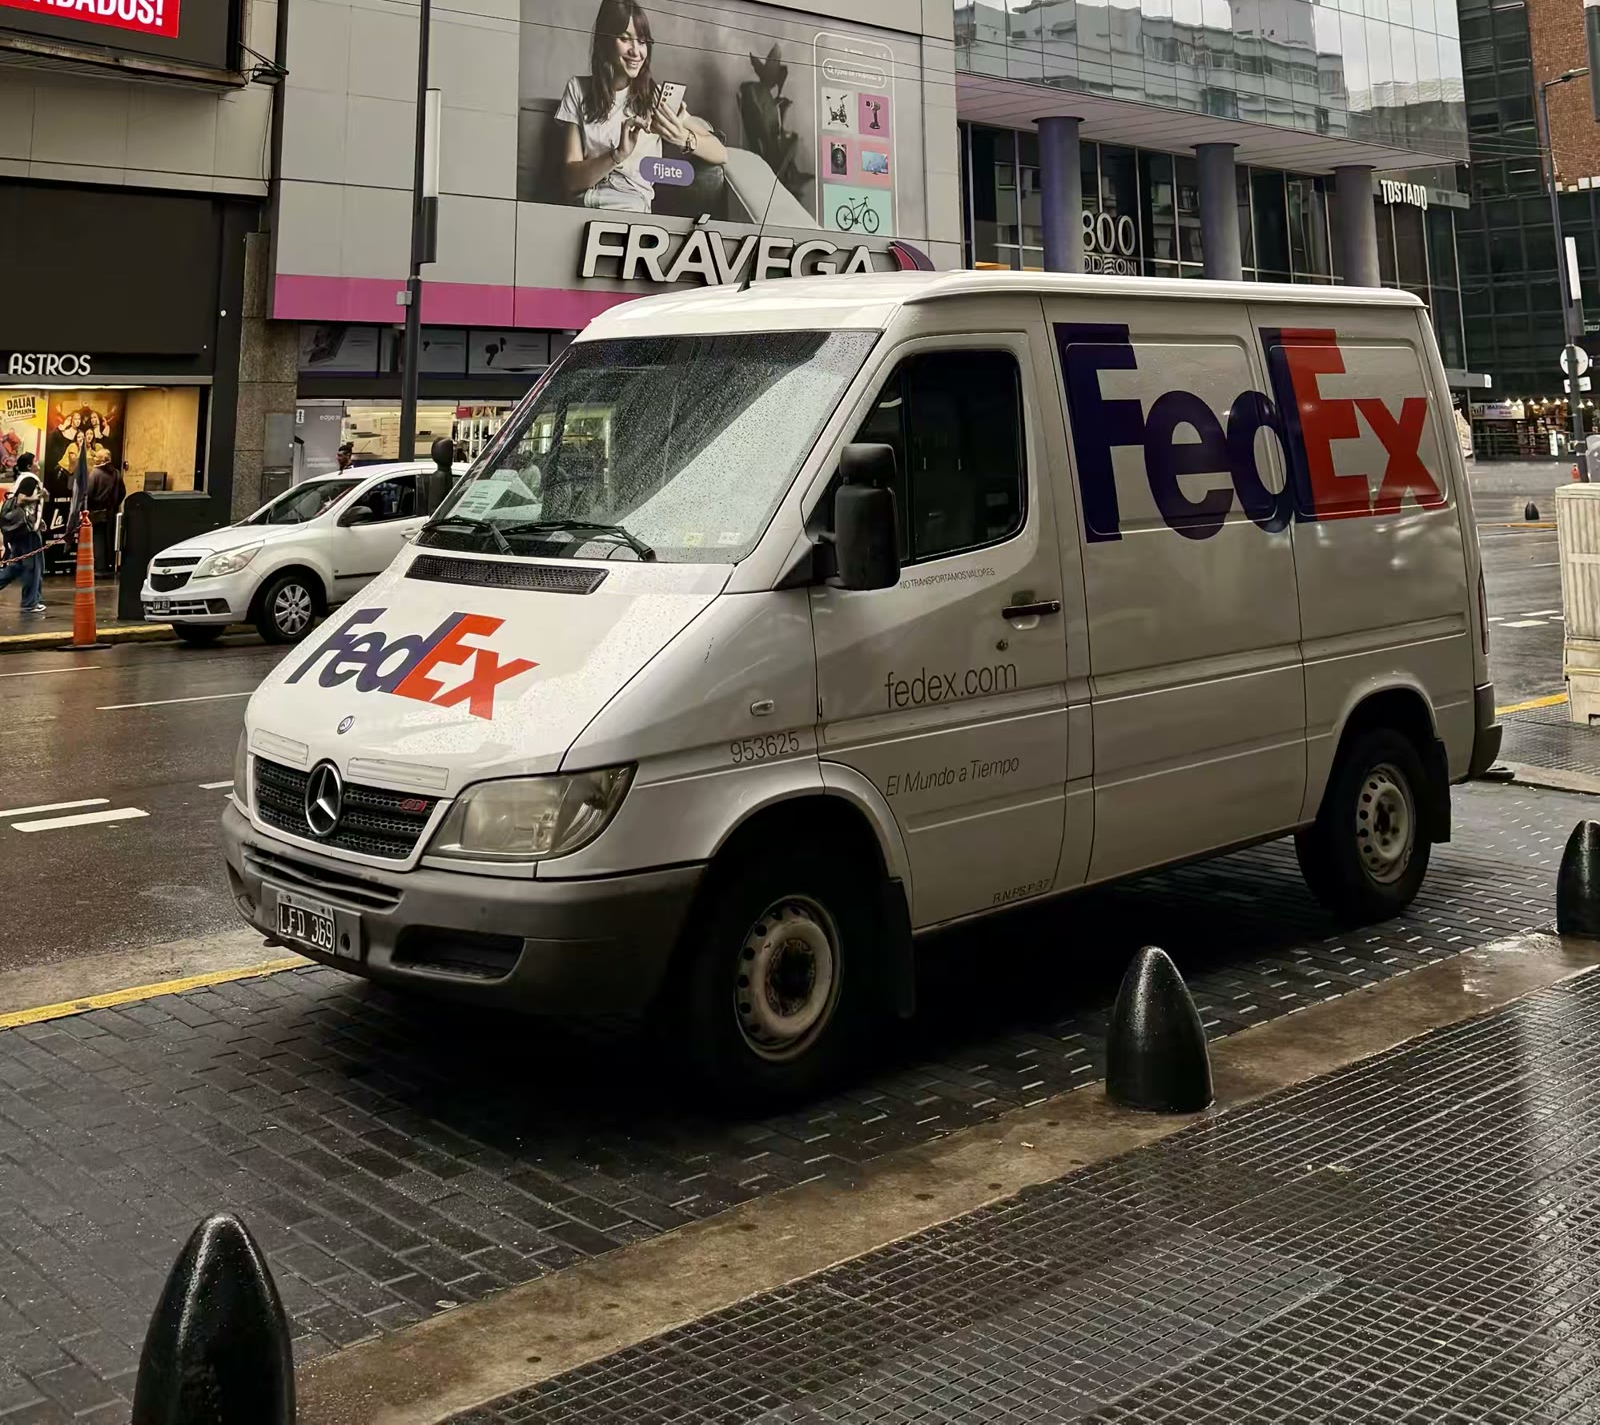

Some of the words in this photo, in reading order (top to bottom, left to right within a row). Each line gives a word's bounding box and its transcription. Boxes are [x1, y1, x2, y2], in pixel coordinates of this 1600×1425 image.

[1380, 179, 1428, 211] TOSTADO
[582, 213, 877, 285] FRÁVEGA
[8, 353, 92, 376] ASTROS
[1053, 322, 1449, 543] FedEx
[284, 607, 540, 720] FedEx
[884, 663, 1017, 709] fedex.com
[730, 731, 800, 763] 953625
[886, 775, 900, 797] El
[904, 767, 955, 793] Mundo
[958, 767, 967, 783] a
[970, 757, 1019, 780] Tiempo
[280, 905, 305, 936] LFD
[311, 915, 333, 949] 369
